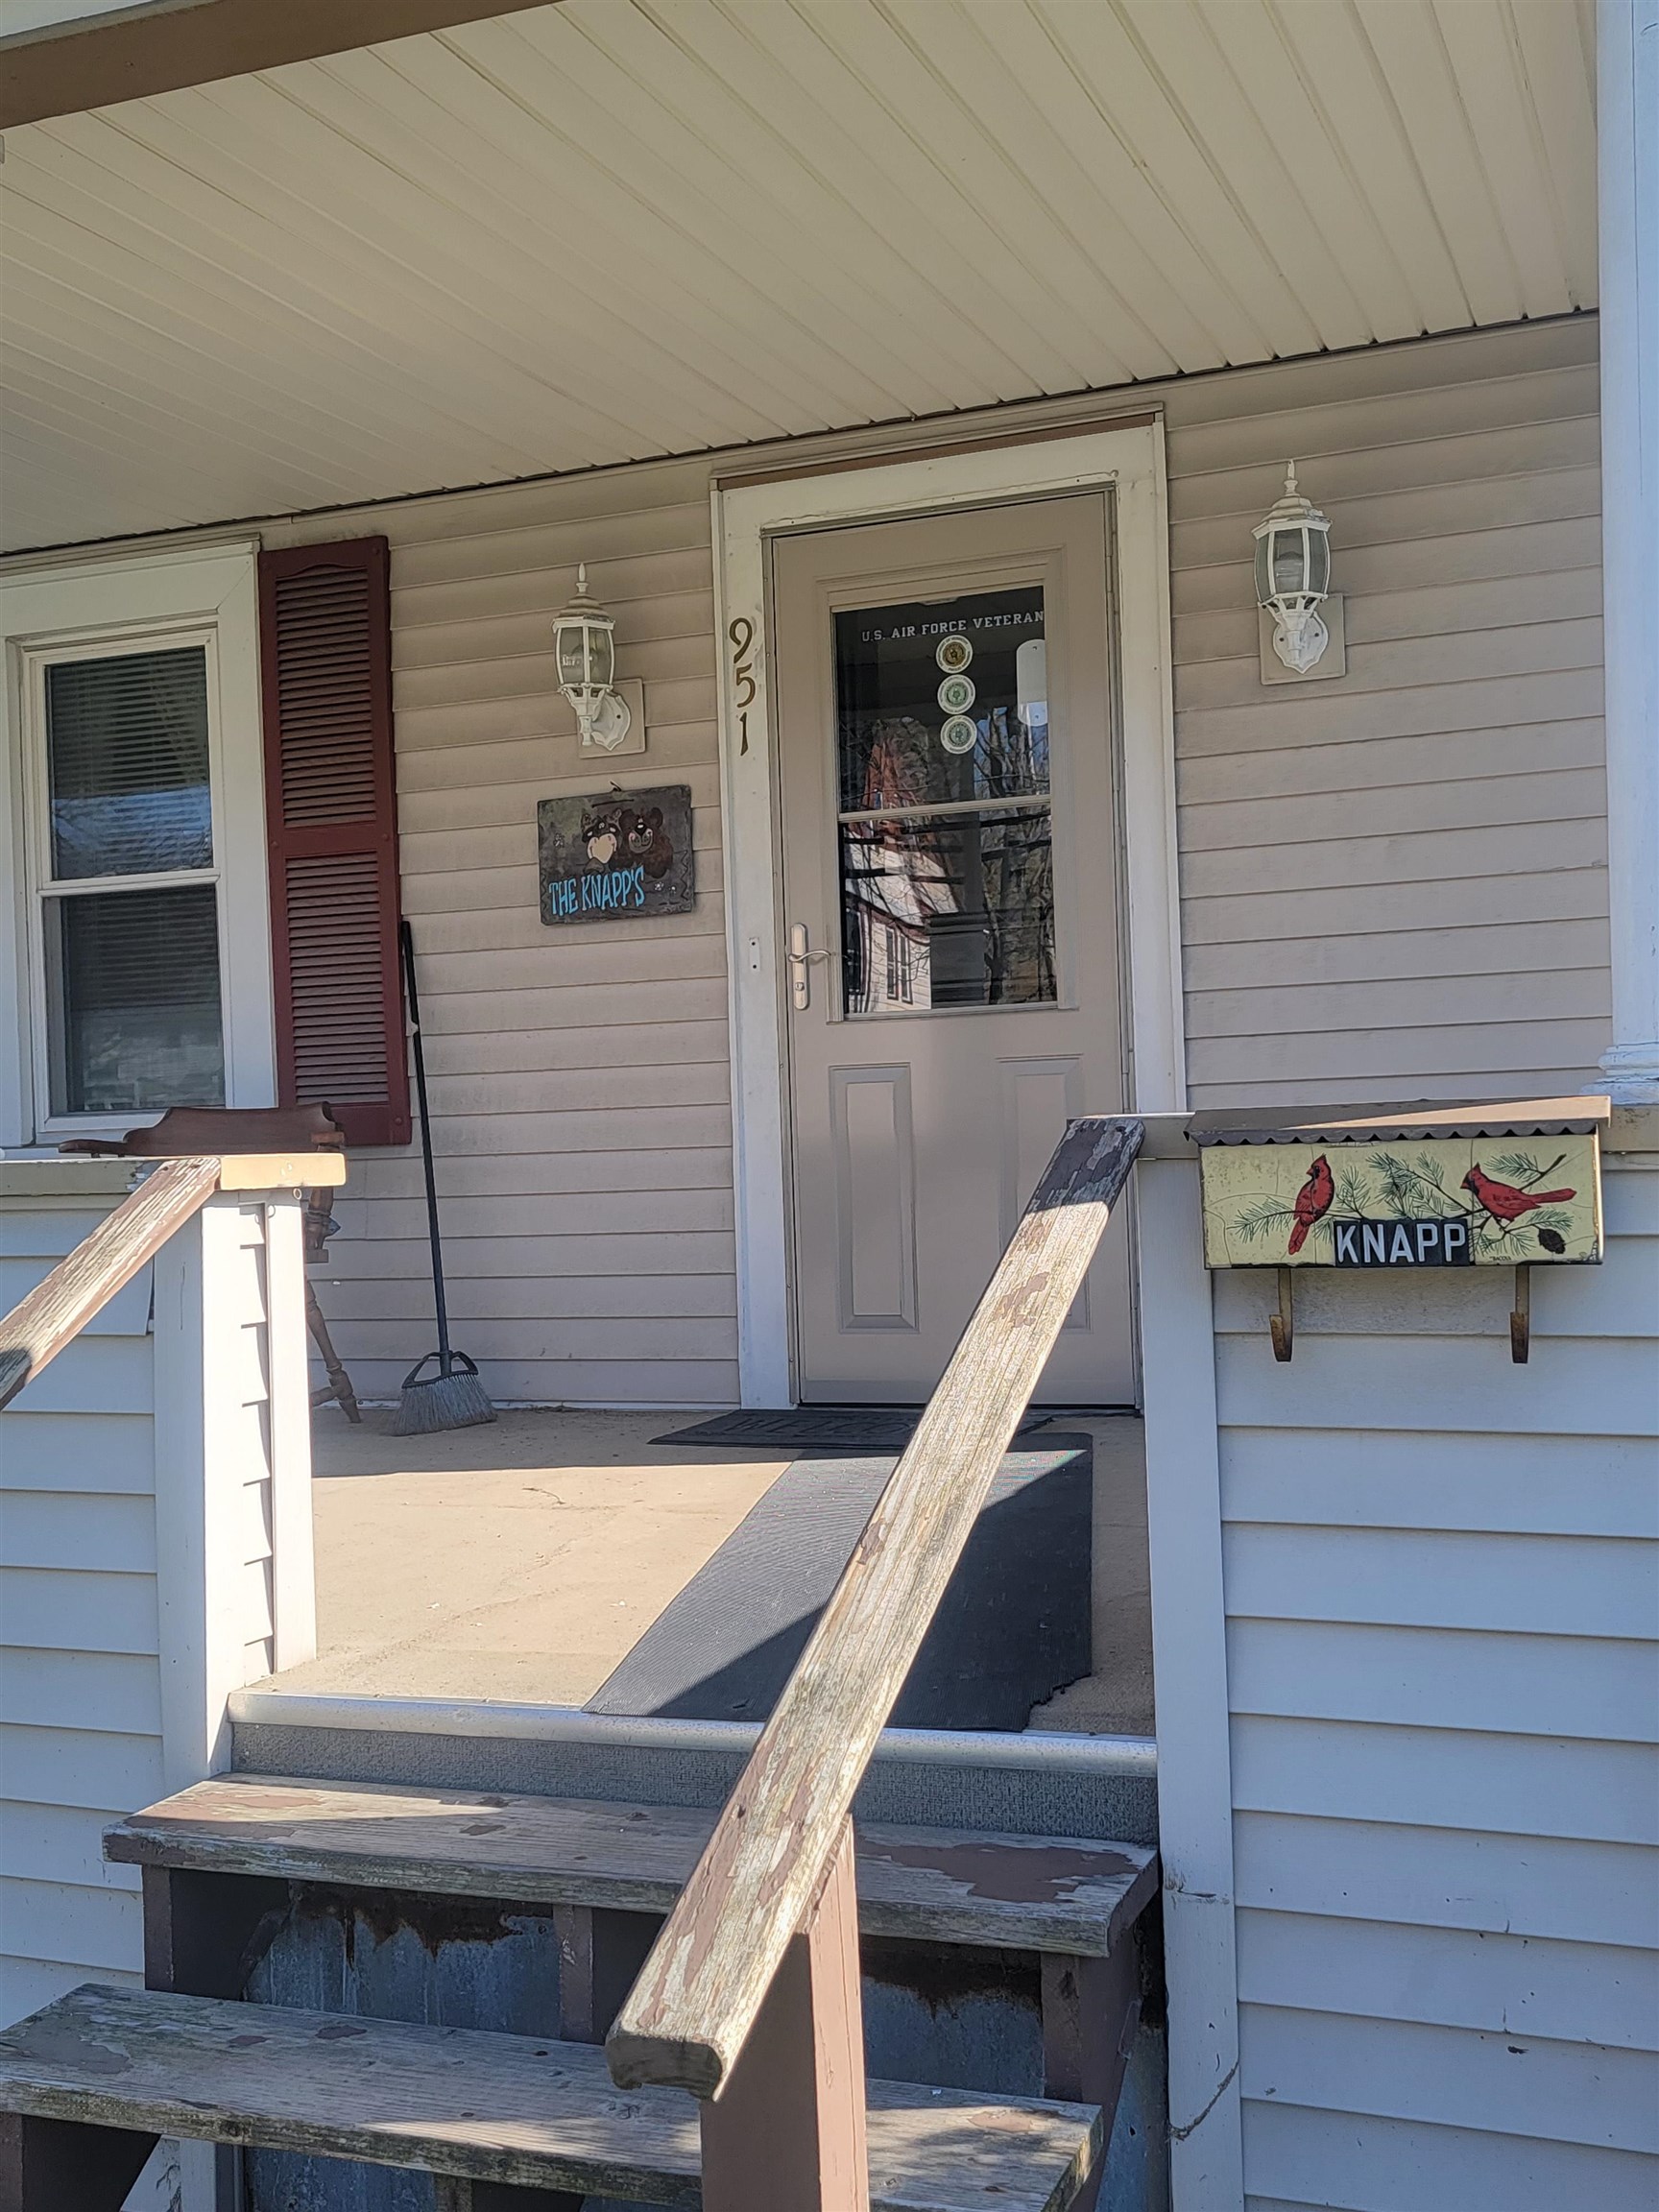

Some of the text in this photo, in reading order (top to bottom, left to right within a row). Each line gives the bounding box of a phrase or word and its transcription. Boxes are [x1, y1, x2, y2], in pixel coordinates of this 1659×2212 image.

[861, 611, 1044, 641] U.S. AIR FORCE VETERAN
[729, 617, 756, 756] 951
[549, 865, 645, 916] THE KNAPP'S
[1336, 1223, 1467, 1263] KNAPP
